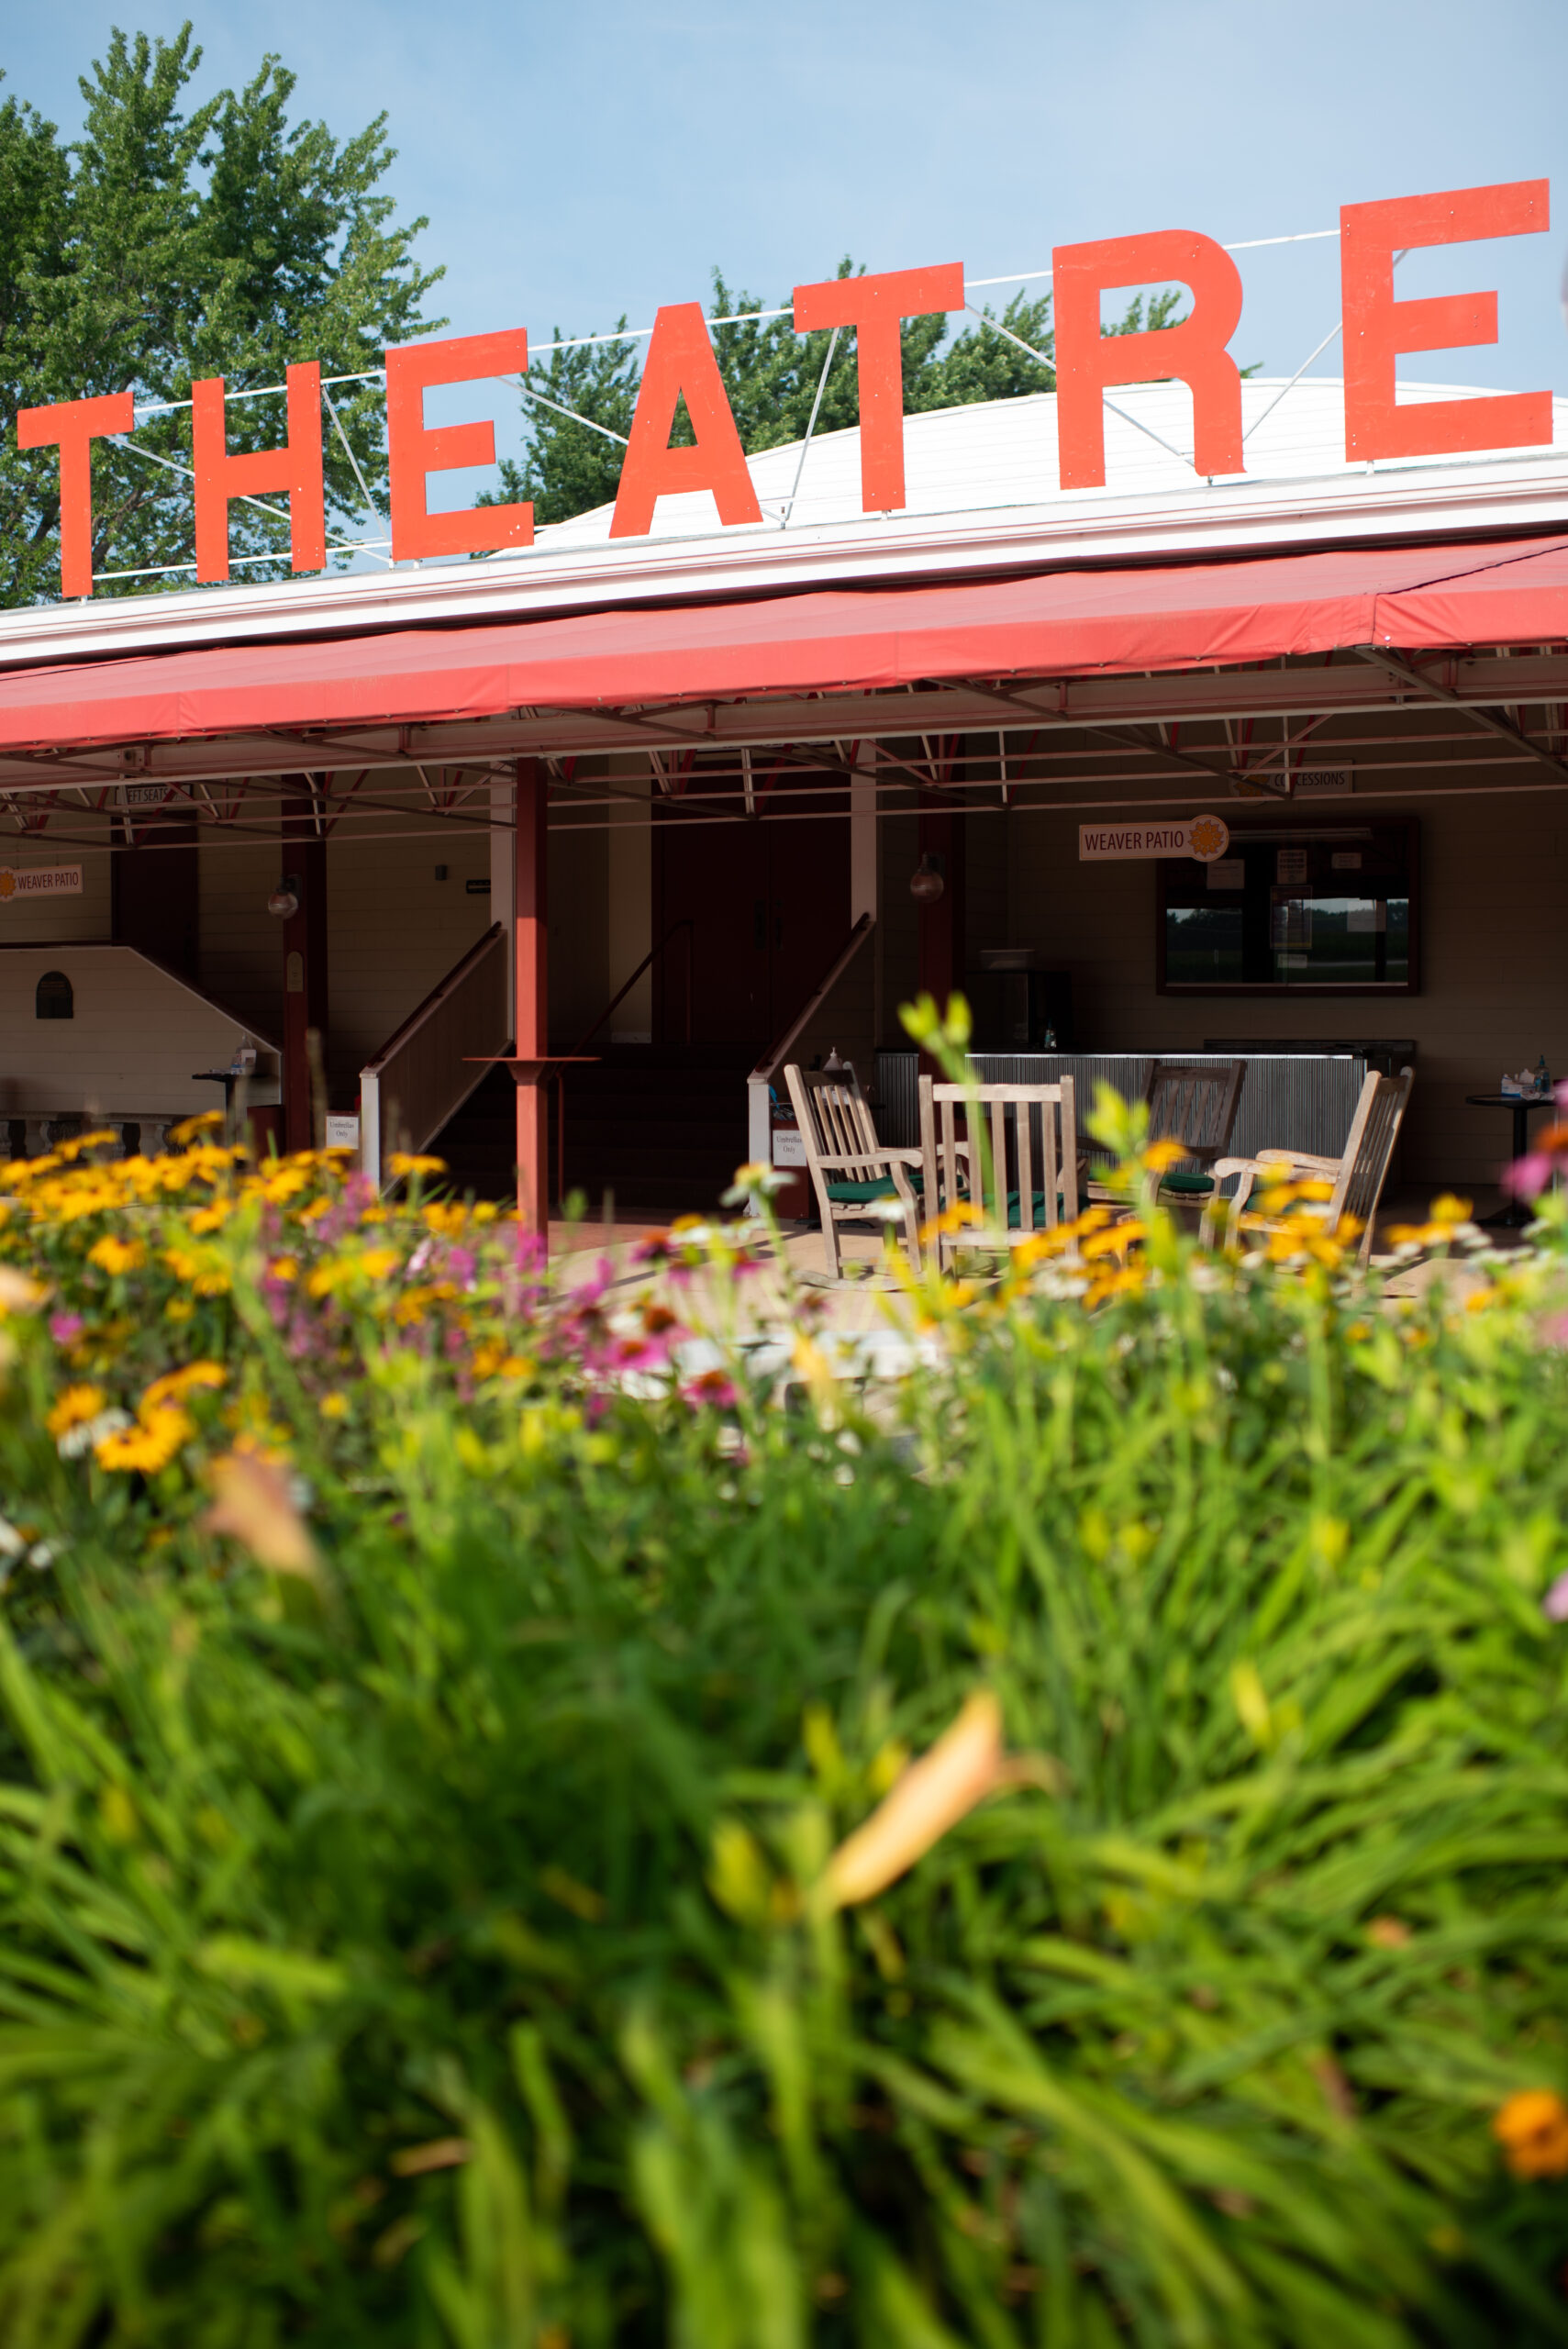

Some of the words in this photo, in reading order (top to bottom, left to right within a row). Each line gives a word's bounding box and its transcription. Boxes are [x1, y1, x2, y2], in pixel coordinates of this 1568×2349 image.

[17, 177, 1553, 597] THEATRE
[1274, 771, 1345, 786] COCESSIONS
[127, 788, 142, 802] EFT
[1084, 832, 1141, 851] WEAVER
[1146, 830, 1184, 849] PATIO
[18, 874, 53, 890] WEAVER
[55, 872, 79, 887] PATIO
[336, 1130, 348, 1138] Only
[783, 1145, 795, 1154] Only
